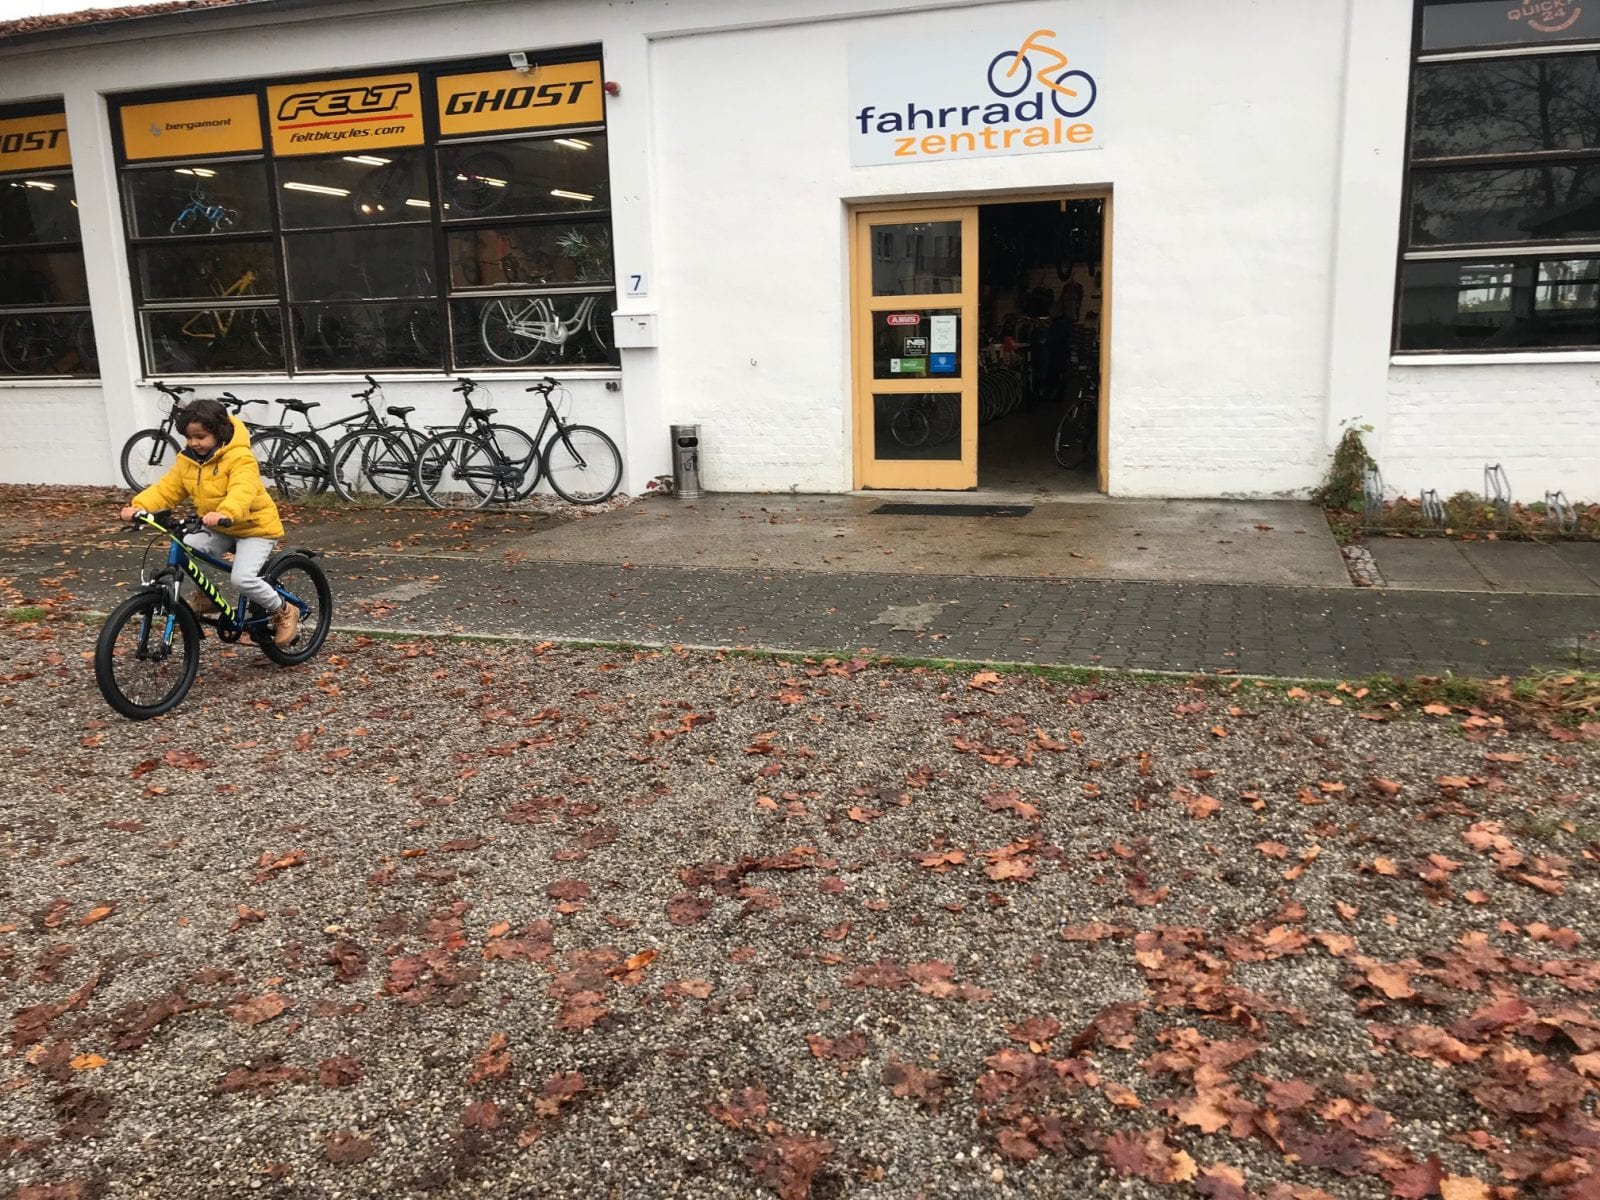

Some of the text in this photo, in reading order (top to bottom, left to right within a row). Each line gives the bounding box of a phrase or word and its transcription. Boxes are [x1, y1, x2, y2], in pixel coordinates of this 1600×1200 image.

[1541, 8, 1567, 21] 24
[277, 83, 412, 121] FELT
[445, 80, 594, 115] GHOST
[165, 118, 231, 130] bergamont
[855, 91, 1043, 134] fahrrad
[0, 128, 67, 153] OST
[290, 125, 405, 142] feltbicycles.com
[894, 117, 1094, 156] zentrale
[630, 275, 641, 291] 7
